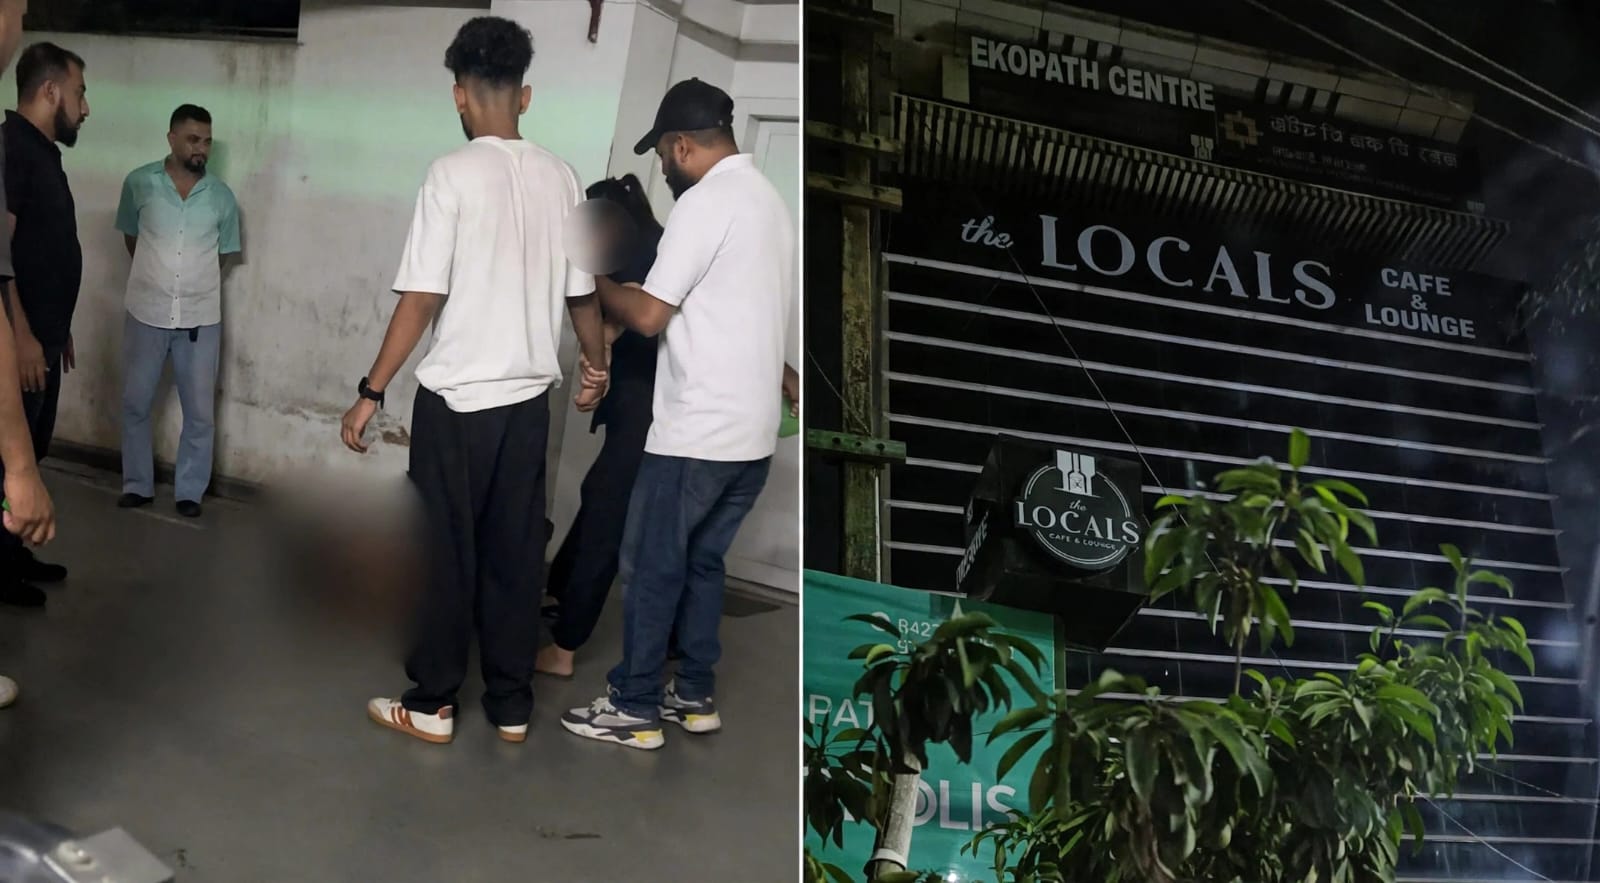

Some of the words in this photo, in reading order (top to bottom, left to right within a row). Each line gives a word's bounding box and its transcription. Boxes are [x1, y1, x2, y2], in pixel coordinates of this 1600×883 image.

[970, 35, 1100, 91] EKOPATH
[1108, 65, 1216, 112] CENTRE
[960, 215, 1014, 249] the
[1039, 213, 1337, 311] LOCALS
[1380, 267, 1452, 297] CAFE
[1410, 293, 1428, 311] &
[1364, 303, 1477, 340] LOUNGE
[1015, 500, 1140, 544] LOCALS
[1069, 499, 1088, 512] the
[1048, 532, 1071, 543] CAFE
[1083, 538, 1116, 550] LOUNGE
